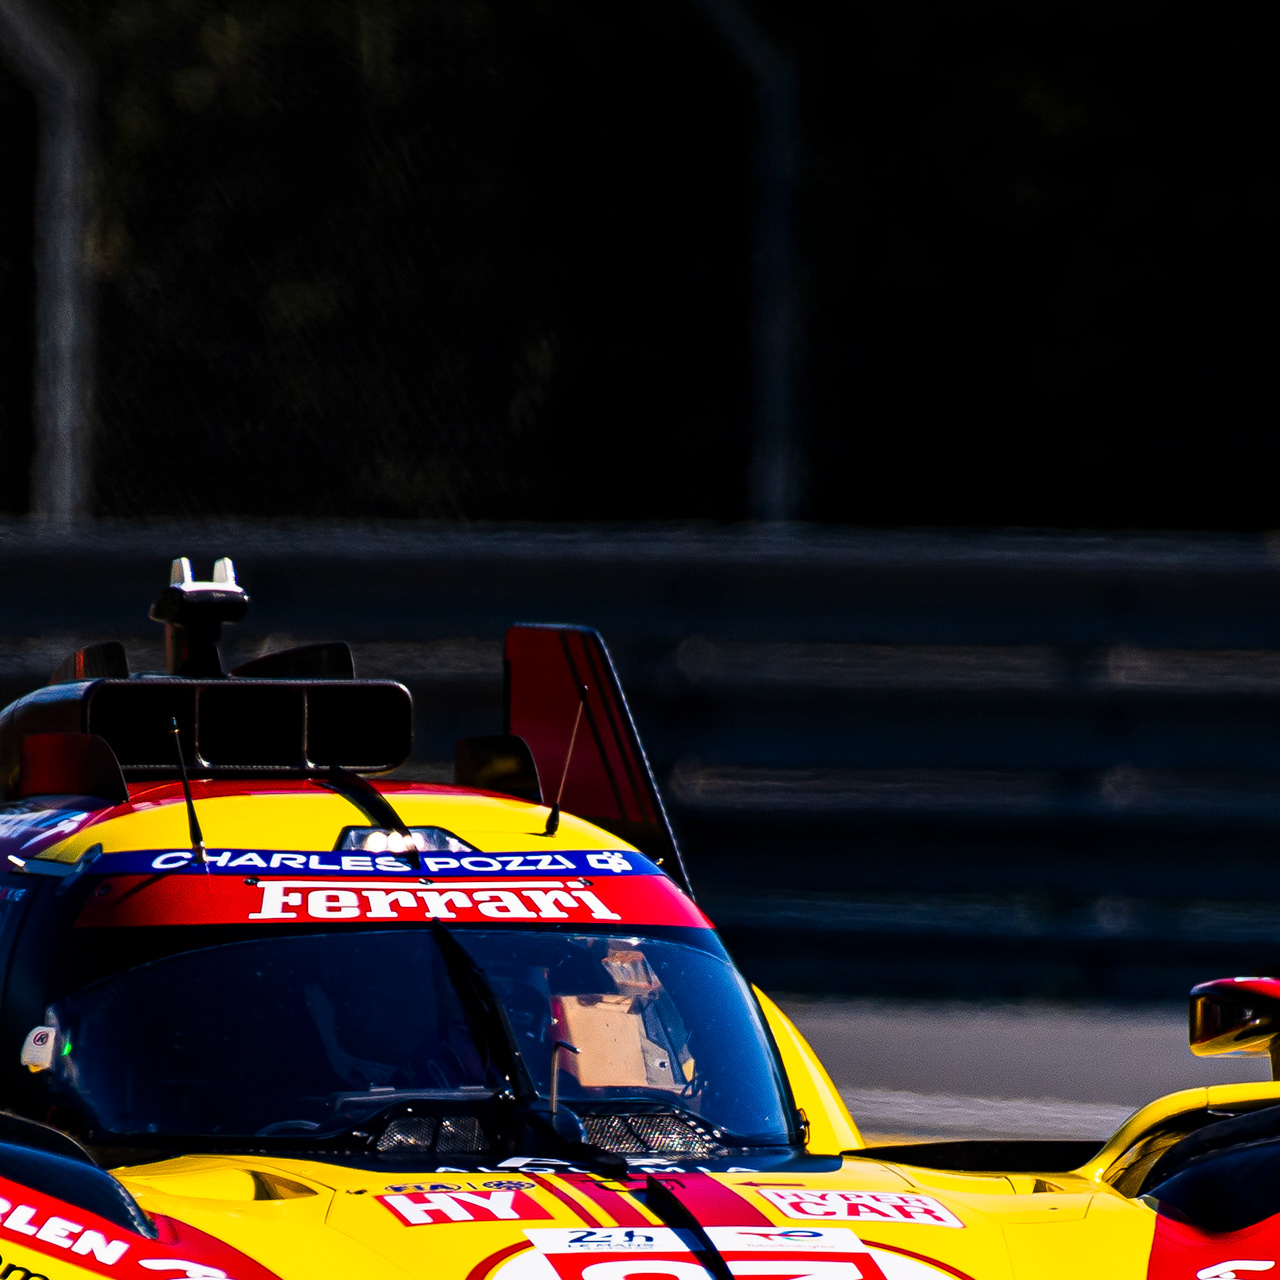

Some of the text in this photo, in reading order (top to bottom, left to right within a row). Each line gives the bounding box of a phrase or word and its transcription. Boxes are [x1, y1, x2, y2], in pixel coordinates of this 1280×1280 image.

[151, 851, 576, 873] CHARLES POZZI
[247, 880, 622, 920] Ferrari
[383, 1191, 521, 1225] HY
[771, 1191, 931, 1206] HYPER
[787, 1201, 947, 1223] CAR
